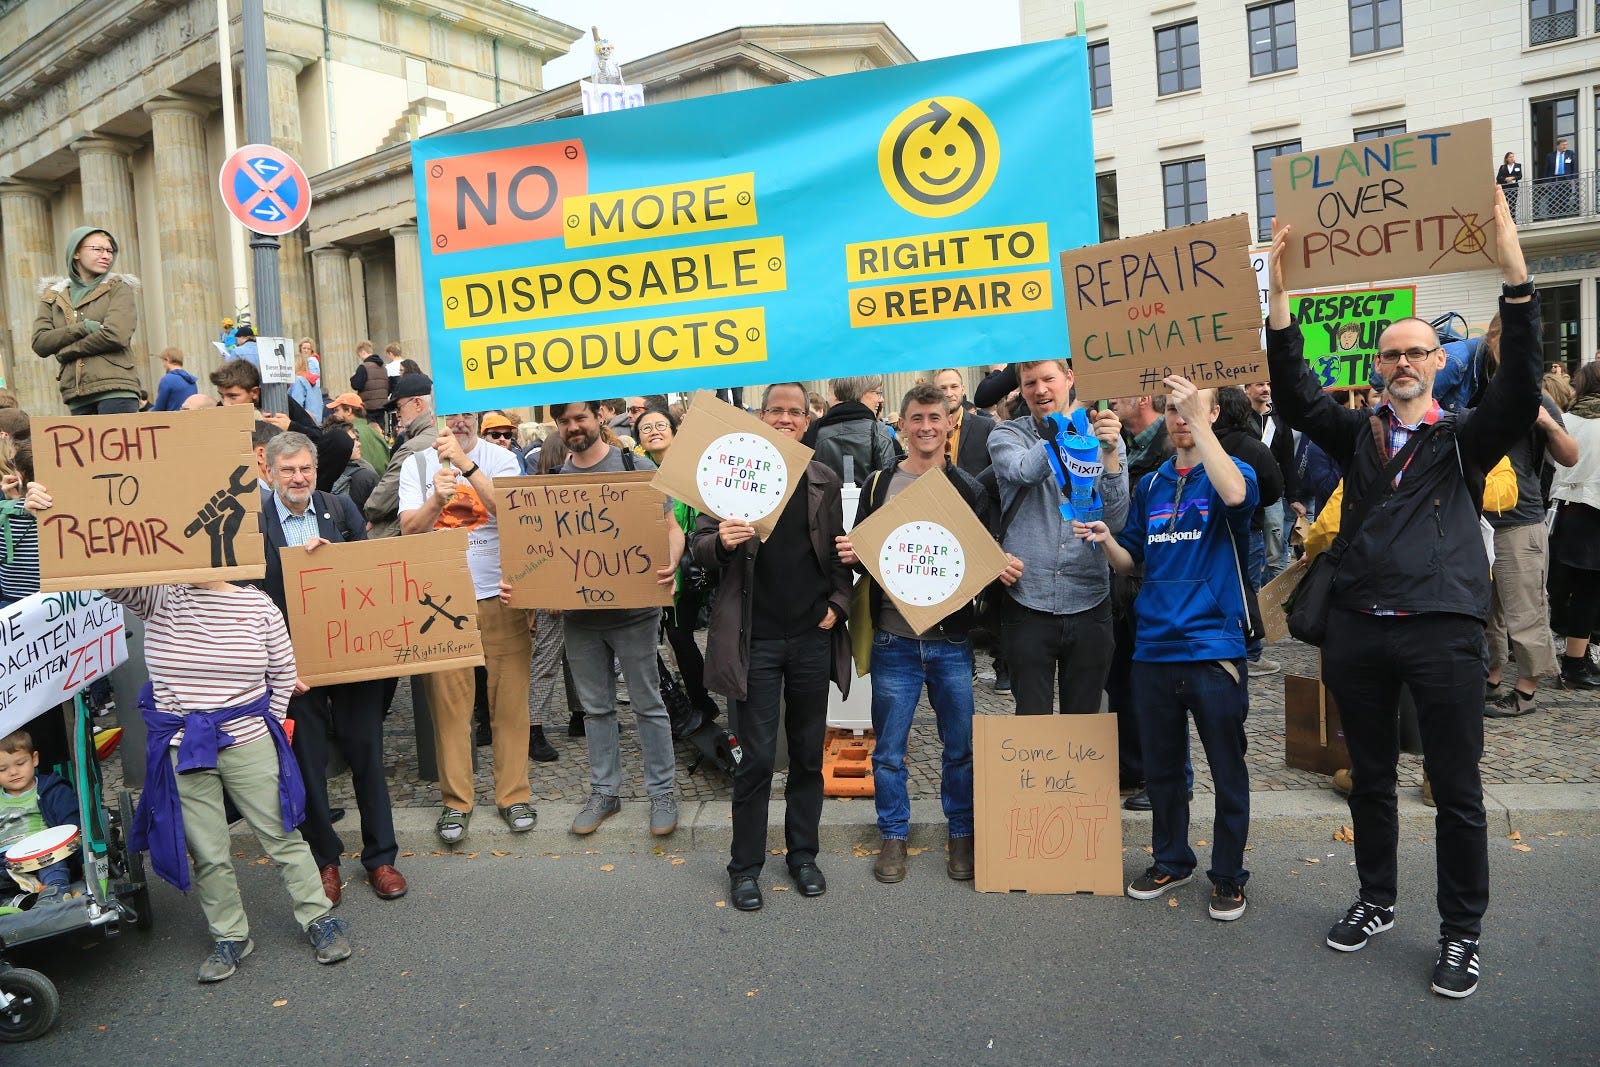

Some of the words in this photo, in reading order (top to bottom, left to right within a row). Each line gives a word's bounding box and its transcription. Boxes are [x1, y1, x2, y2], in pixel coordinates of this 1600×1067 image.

[1290, 133, 1451, 190] PLANET
[456, 165, 558, 230] NO
[589, 184, 728, 236] MORE
[1318, 178, 1408, 229] OVER
[858, 236, 970, 274] RIGHT
[983, 231, 1036, 261] TO
[1303, 215, 1458, 269] PROFIT
[465, 248, 758, 318] DISPOSABLE
[1075, 240, 1224, 310] REPAIR
[885, 281, 1012, 318] REPAIR
[1127, 302, 1166, 321] OUR
[1298, 293, 1395, 325] RESPECT
[486, 318, 739, 380] PRODUCTS
[1084, 312, 1233, 361] CLIMATE
[1139, 360, 1260, 391] #RhtToRepair
[44, 424, 171, 468] RIGHT
[719, 454, 771, 471] REPAIR
[731, 467, 756, 481] FOR
[92, 473, 139, 506] TO
[505, 488, 537, 511] I'm
[544, 485, 590, 505] here
[599, 483, 629, 505] for
[716, 476, 767, 493] FUTURE
[43, 513, 185, 560] REPAIR
[518, 513, 543, 532] my
[1147, 528, 1202, 545] patagonia
[469, 538, 488, 546] stice
[526, 540, 554, 559] and
[898, 543, 948, 556] REPAIR
[897, 564, 946, 577] FUTURE
[910, 554, 935, 566] FOR
[300, 567, 376, 615] Fix
[576, 586, 615, 604] too
[0, 611, 25, 647] IE
[41, 589, 104, 622] DINO
[83, 602, 119, 634] AUCH
[327, 616, 415, 658] Planet
[393, 640, 475, 663] #RightToRepair
[63, 624, 124, 691] ZEIT
[1001, 738, 1060, 762] Some
[1020, 768, 1035, 789] it
[1045, 770, 1076, 790] not
[1006, 804, 1108, 861] HOT
